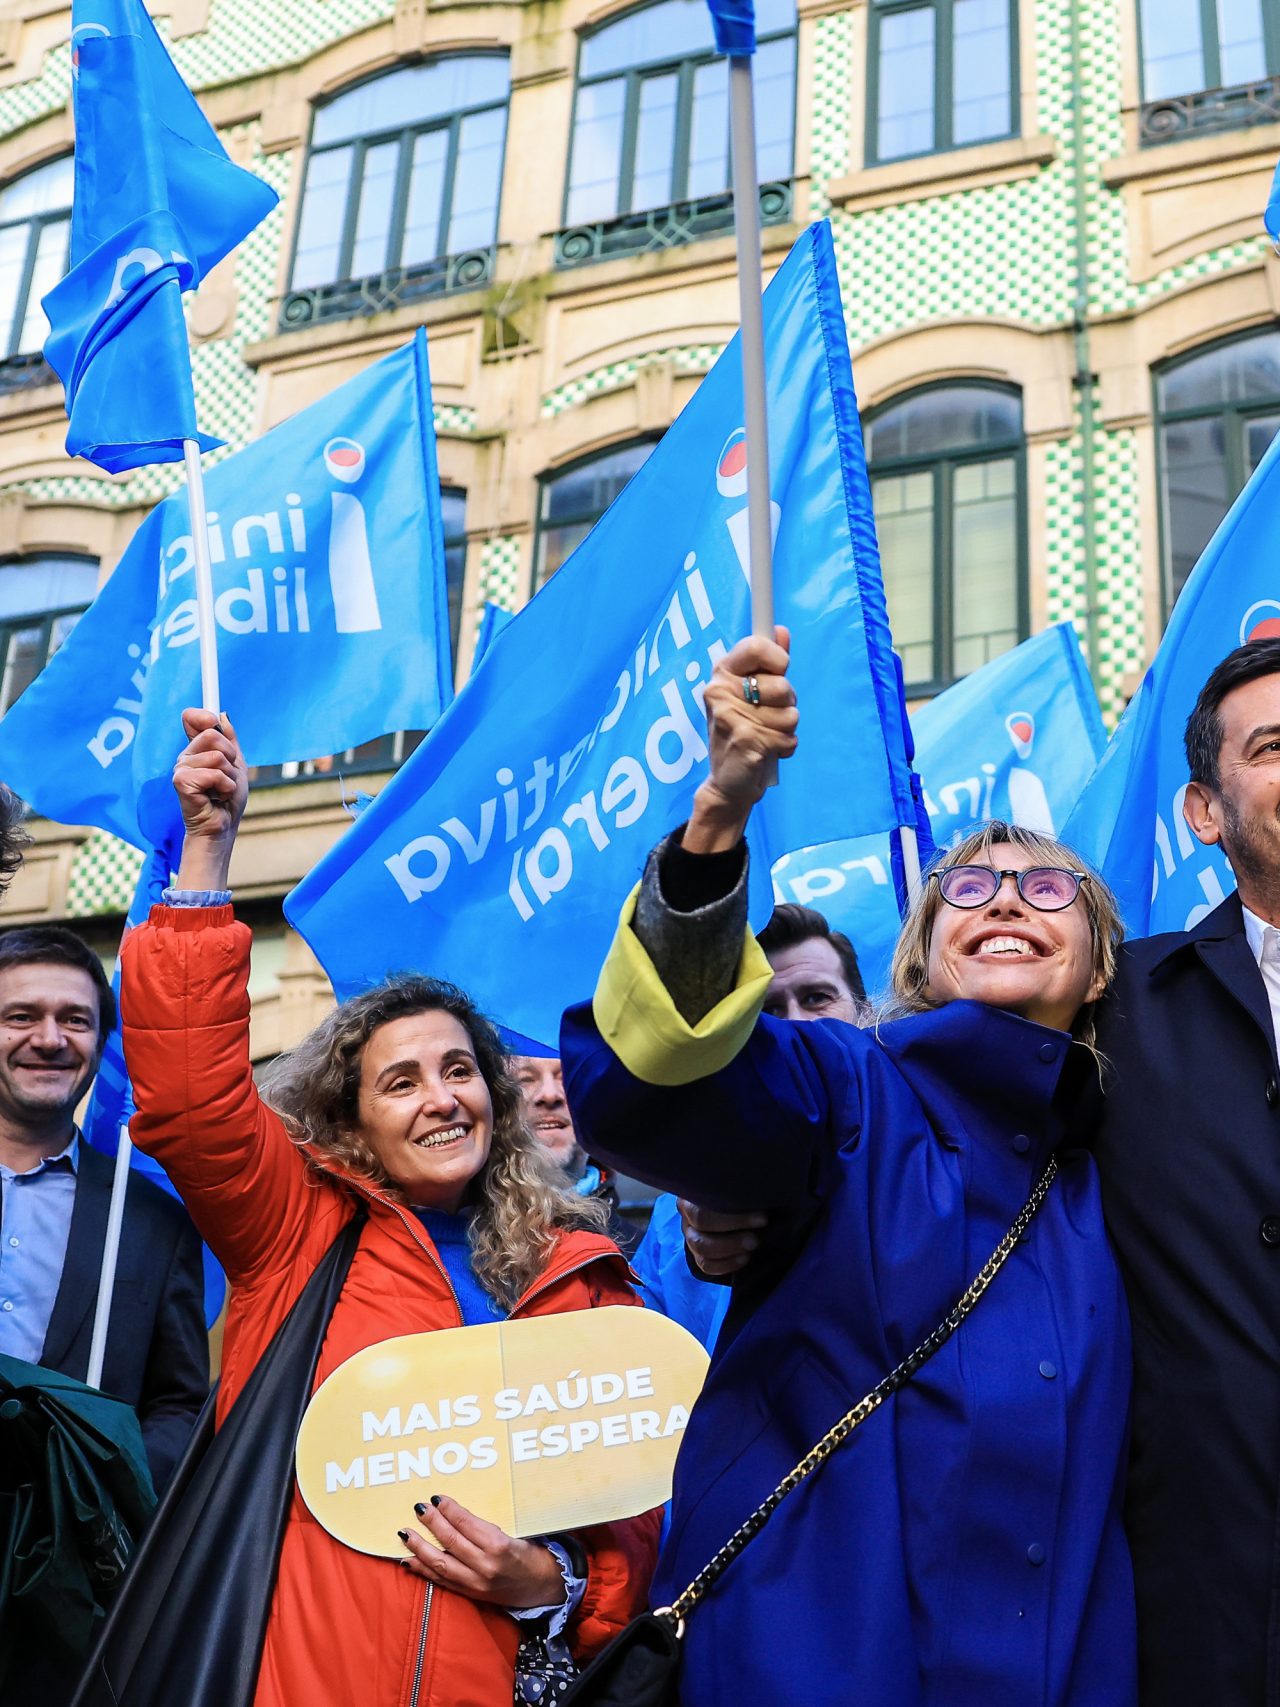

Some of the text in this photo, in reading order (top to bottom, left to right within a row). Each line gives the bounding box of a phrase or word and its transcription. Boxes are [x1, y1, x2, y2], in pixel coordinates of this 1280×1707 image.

[362, 1367, 655, 1442] MAIS SAÚDE
[325, 1404, 692, 1494] MENOS ESPERA
